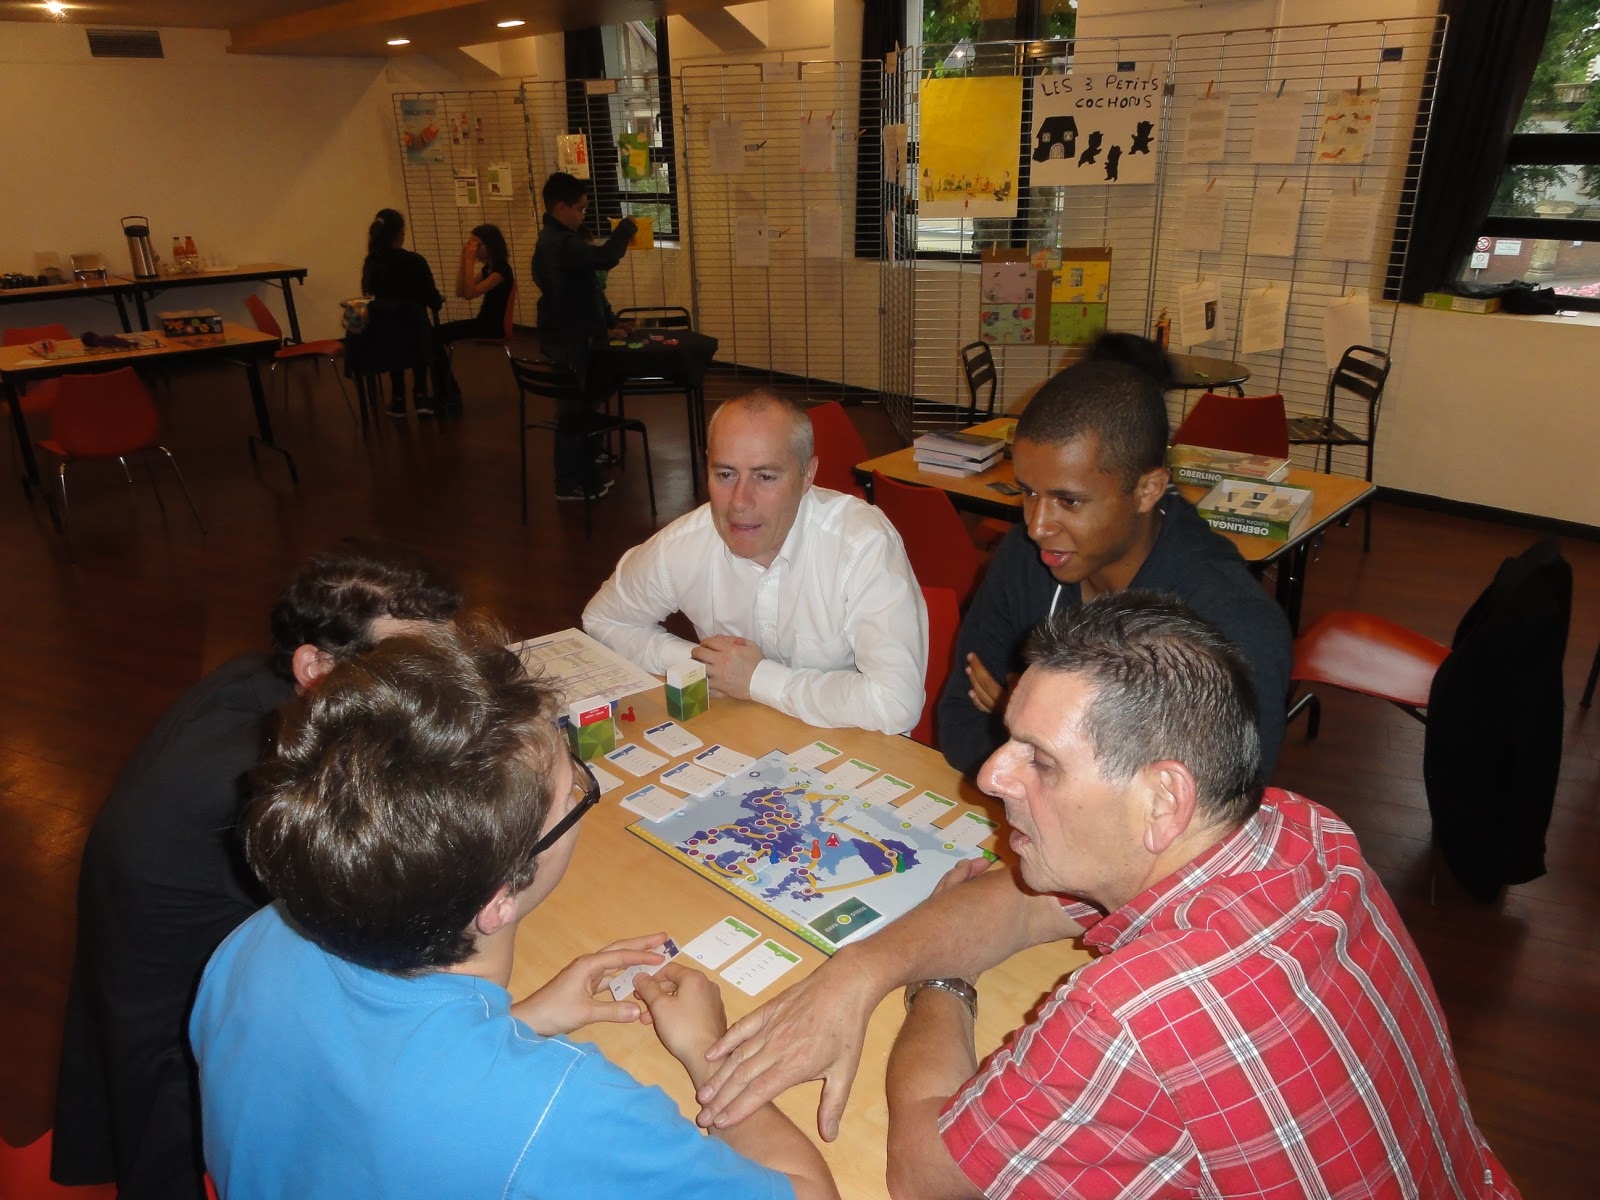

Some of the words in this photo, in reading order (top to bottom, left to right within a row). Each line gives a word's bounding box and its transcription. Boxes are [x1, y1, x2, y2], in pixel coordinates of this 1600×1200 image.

[1041, 78, 1072, 97] LES
[1086, 77, 1093, 91] 3
[1075, 95, 1153, 109] COCHONS
[1179, 469, 1222, 482] OBERLING
